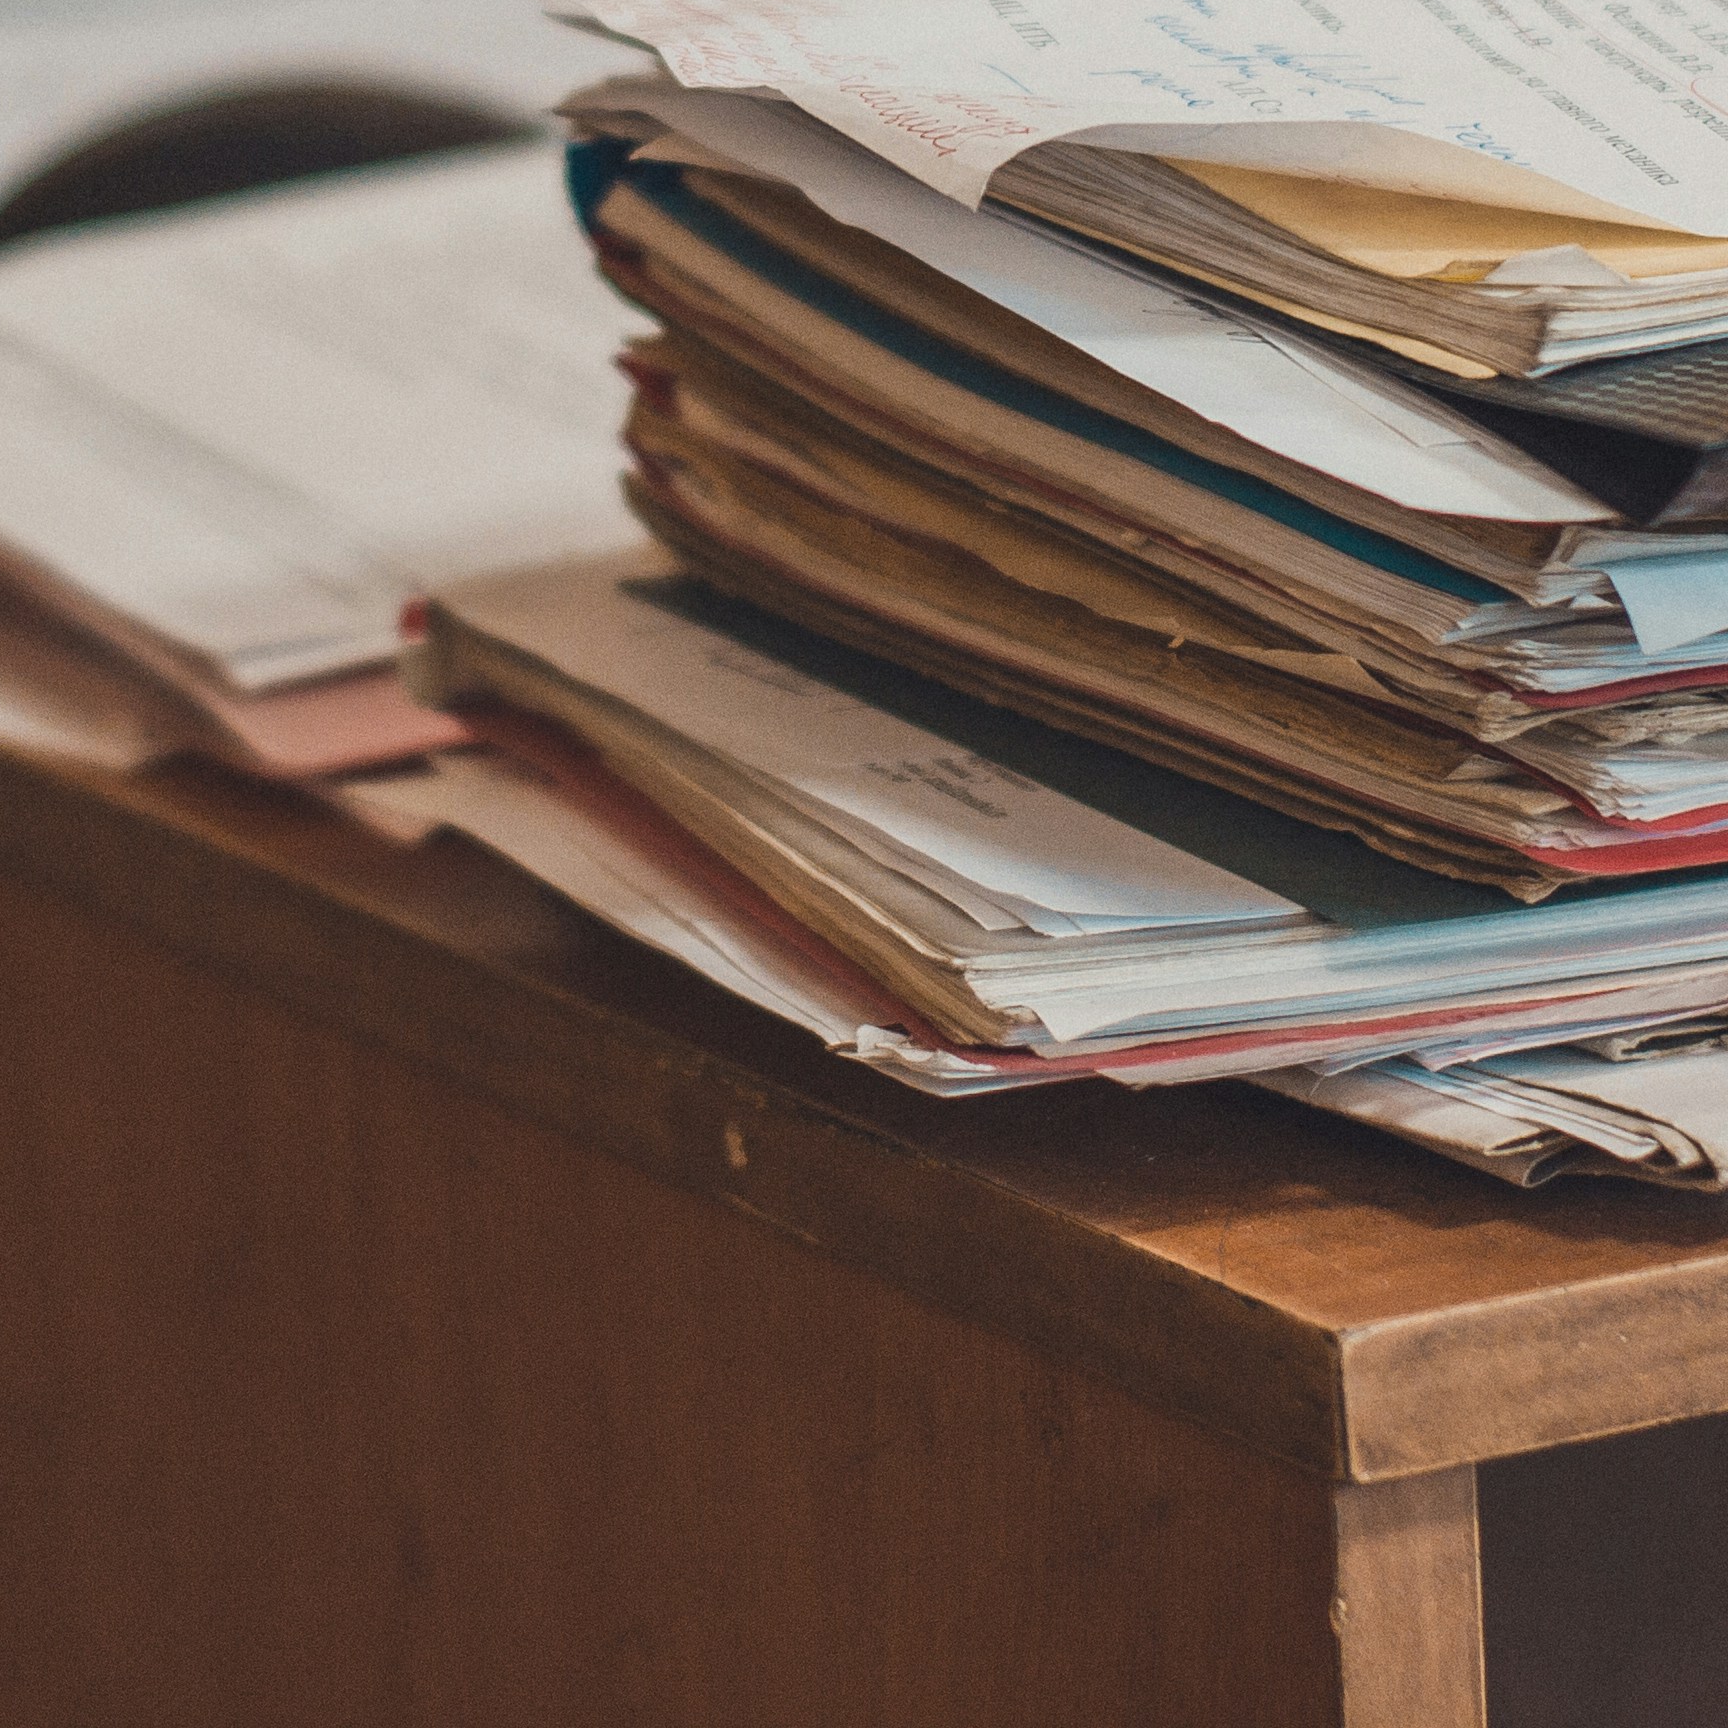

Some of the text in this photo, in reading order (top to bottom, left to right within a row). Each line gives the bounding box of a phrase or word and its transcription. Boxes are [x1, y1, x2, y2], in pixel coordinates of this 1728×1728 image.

[1009, 20, 1061, 52] ИТБ.
[1536, 88, 1610, 134] главного
[1604, 134, 1680, 187] механика
